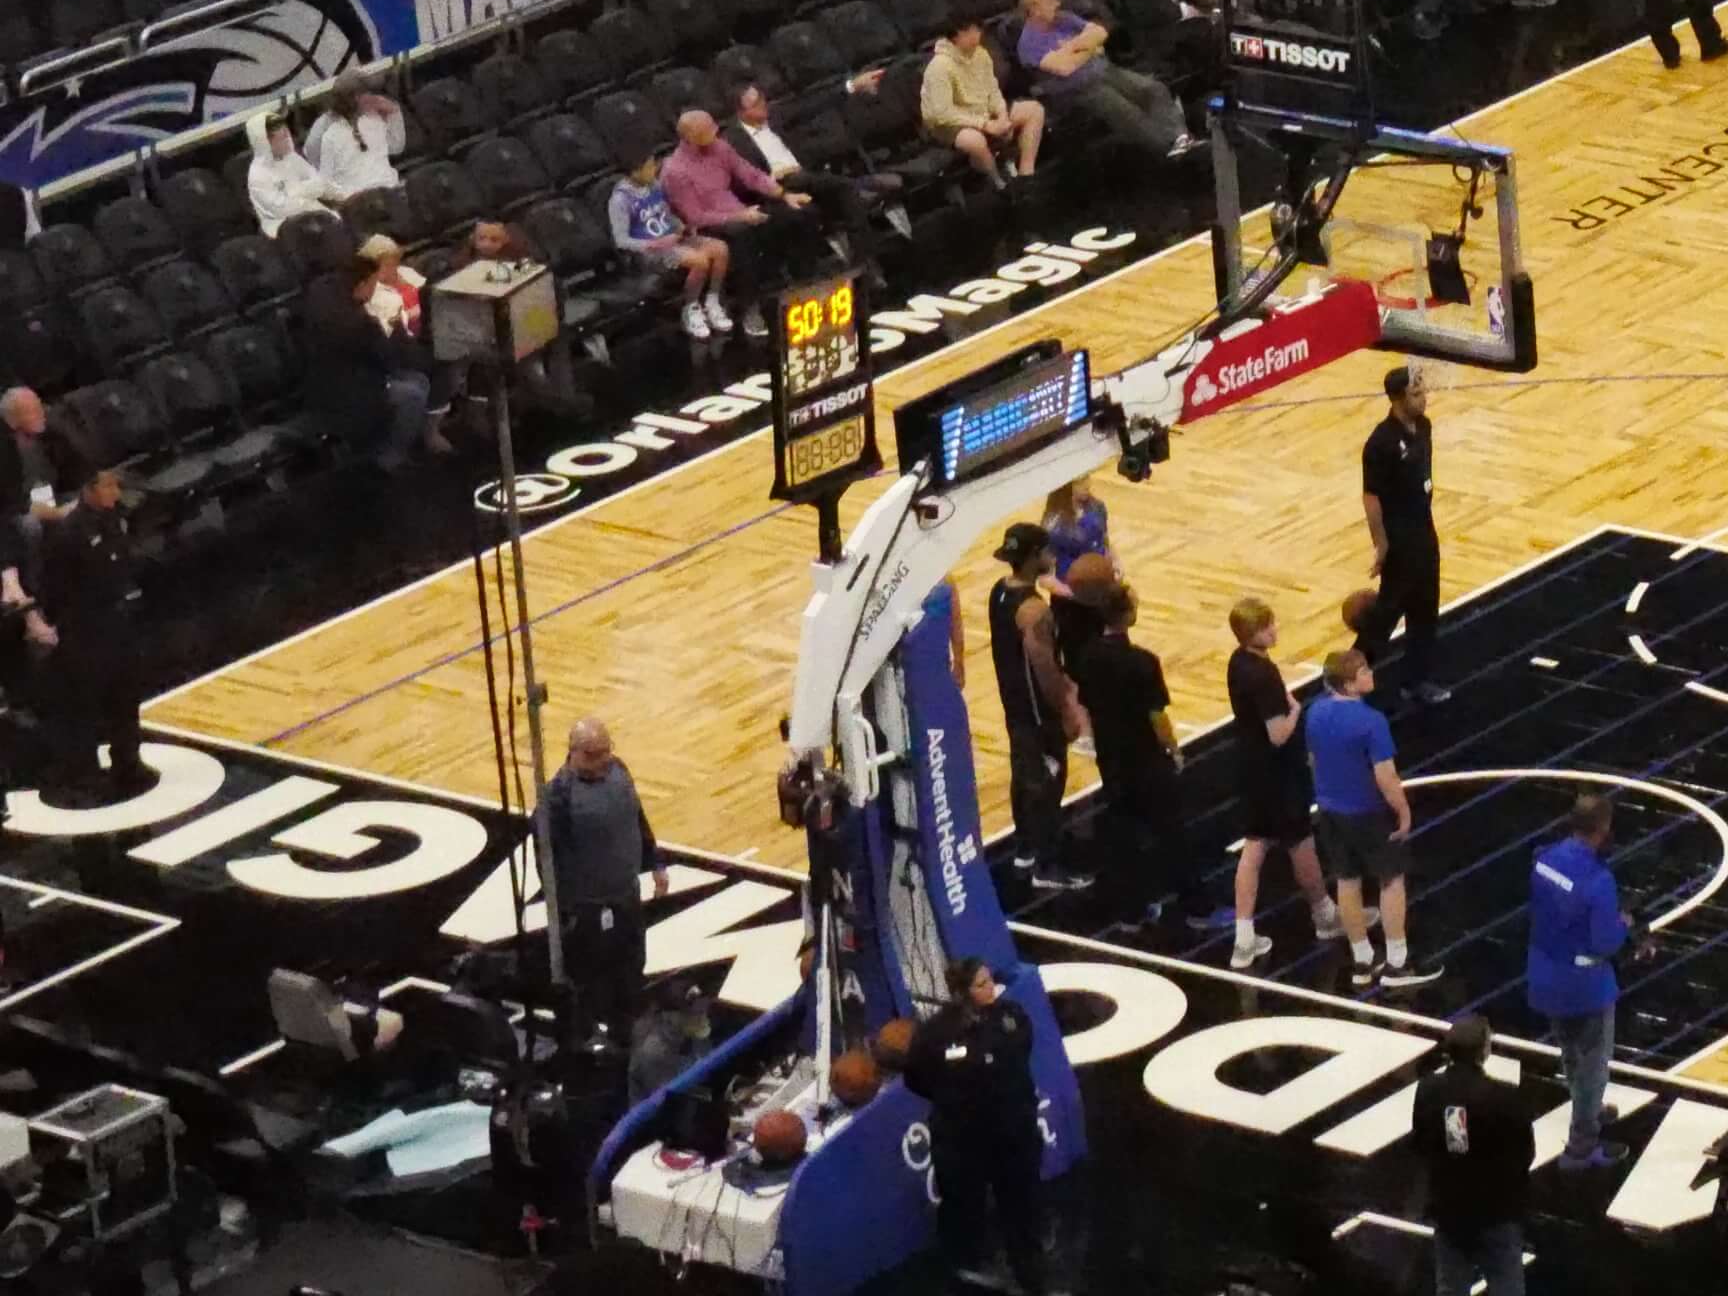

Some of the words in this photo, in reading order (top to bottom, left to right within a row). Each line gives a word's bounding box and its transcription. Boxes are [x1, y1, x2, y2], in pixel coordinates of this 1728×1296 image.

[1262, 38, 1351, 73] TISSOT
[786, 285, 854, 345] 50:19
[474, 225, 1138, 513] @OrlanoMagic
[811, 384, 869, 421] TISSOT
[924, 726, 967, 919] AdventHealth
